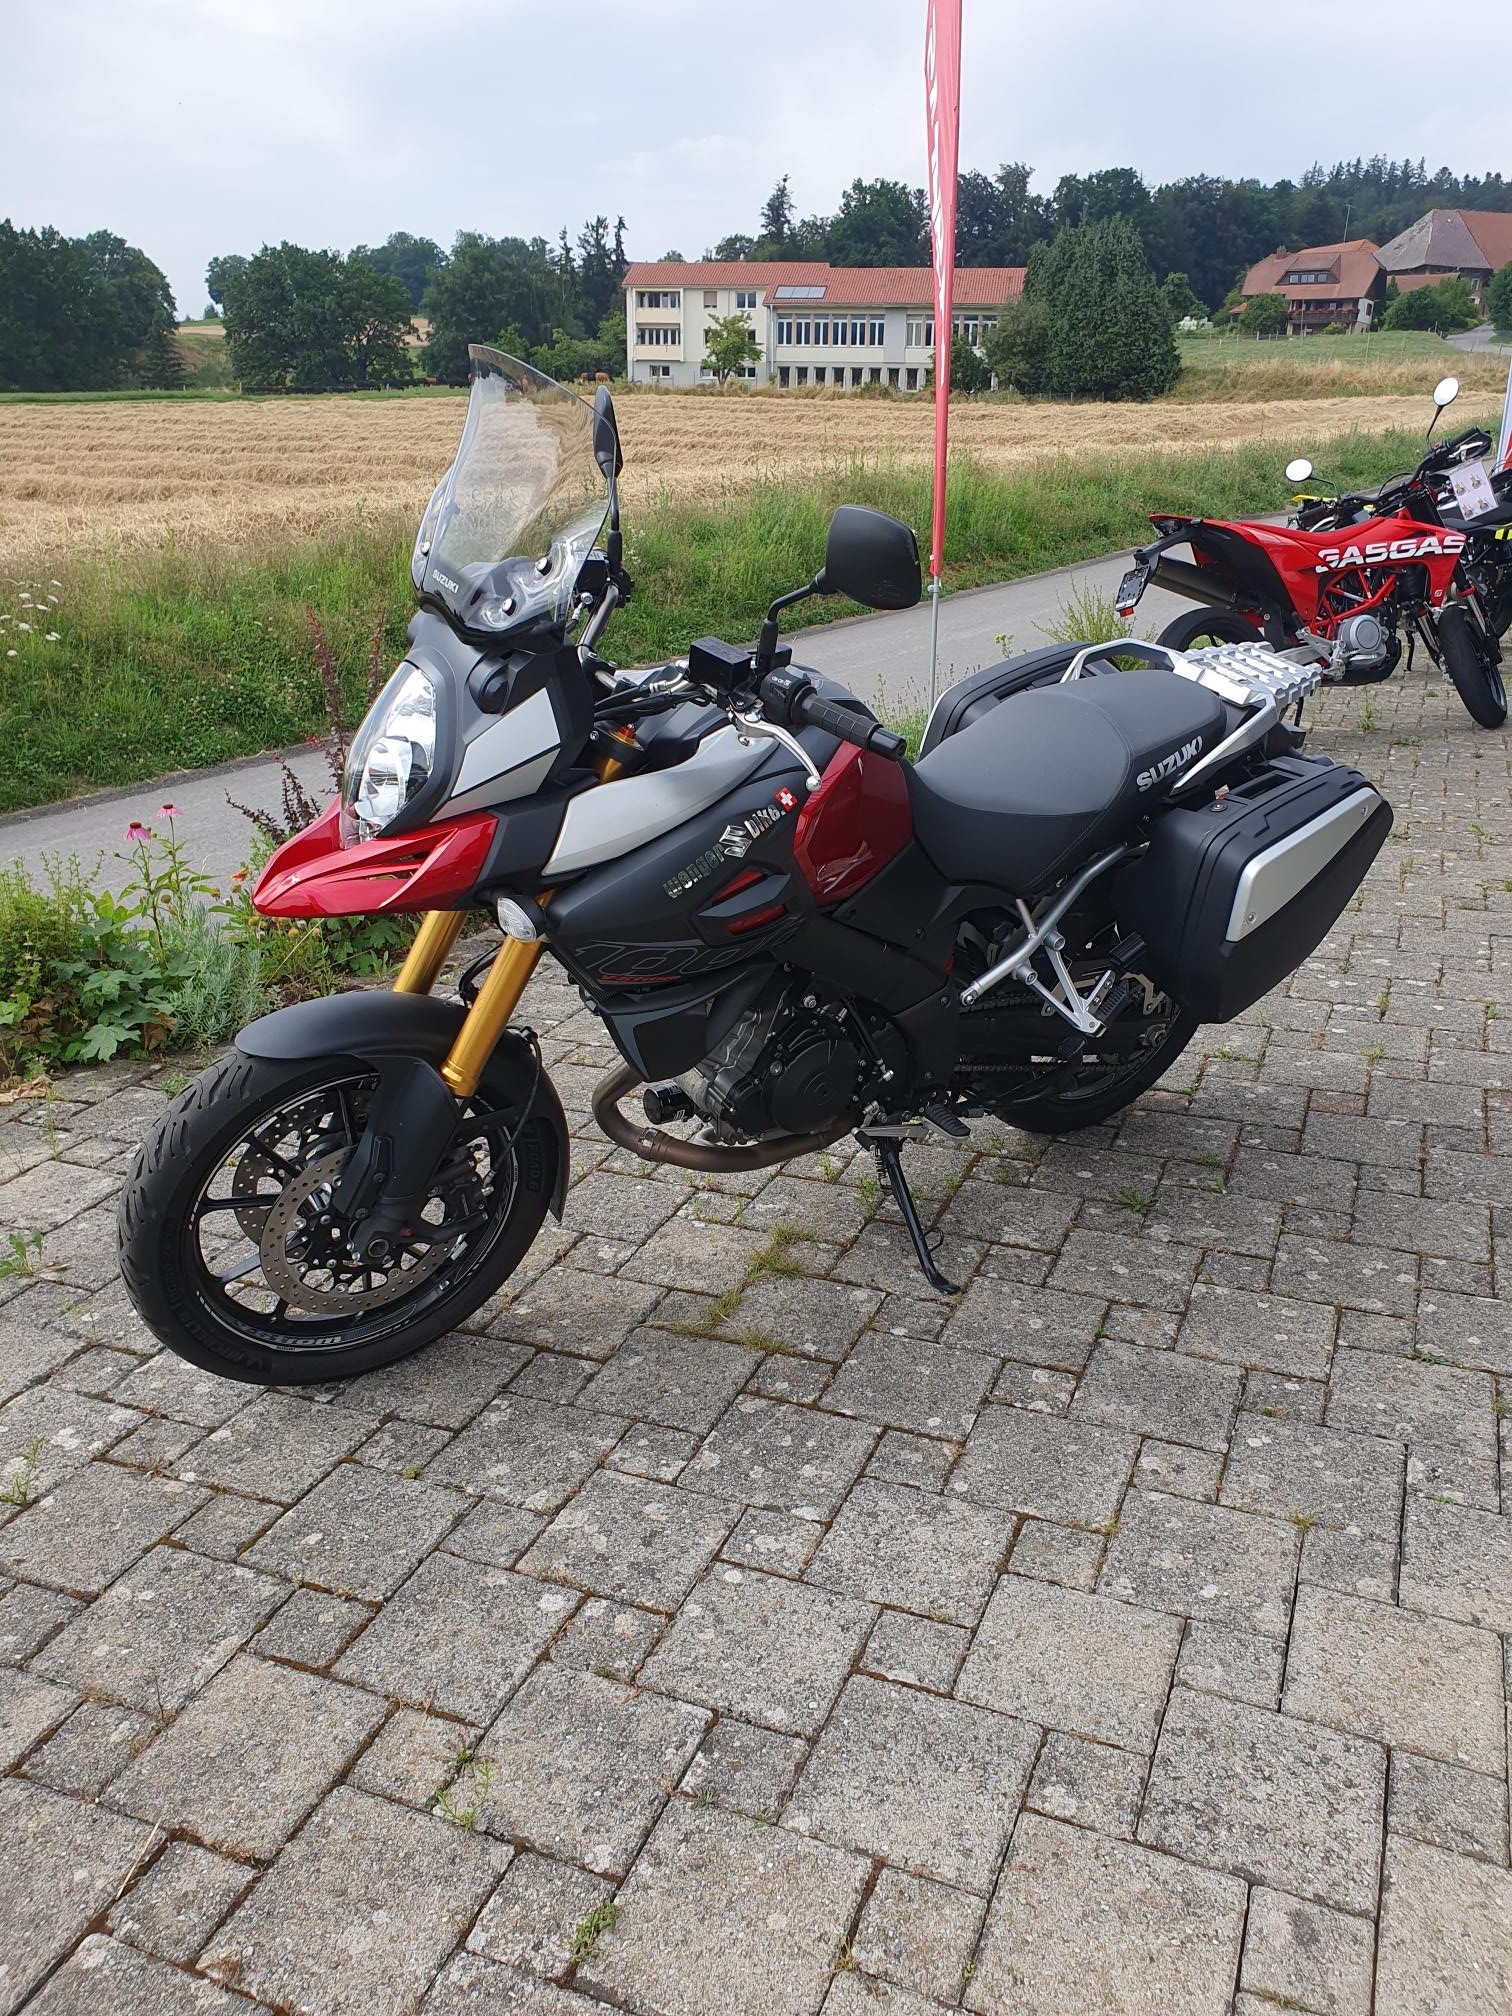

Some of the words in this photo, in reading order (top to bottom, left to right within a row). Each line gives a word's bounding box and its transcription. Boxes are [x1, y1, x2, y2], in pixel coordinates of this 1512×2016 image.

[1315, 535, 1466, 574] GASGAS
[432, 569, 459, 594] SUZUKI
[1136, 735, 1203, 792] SUZUKI
